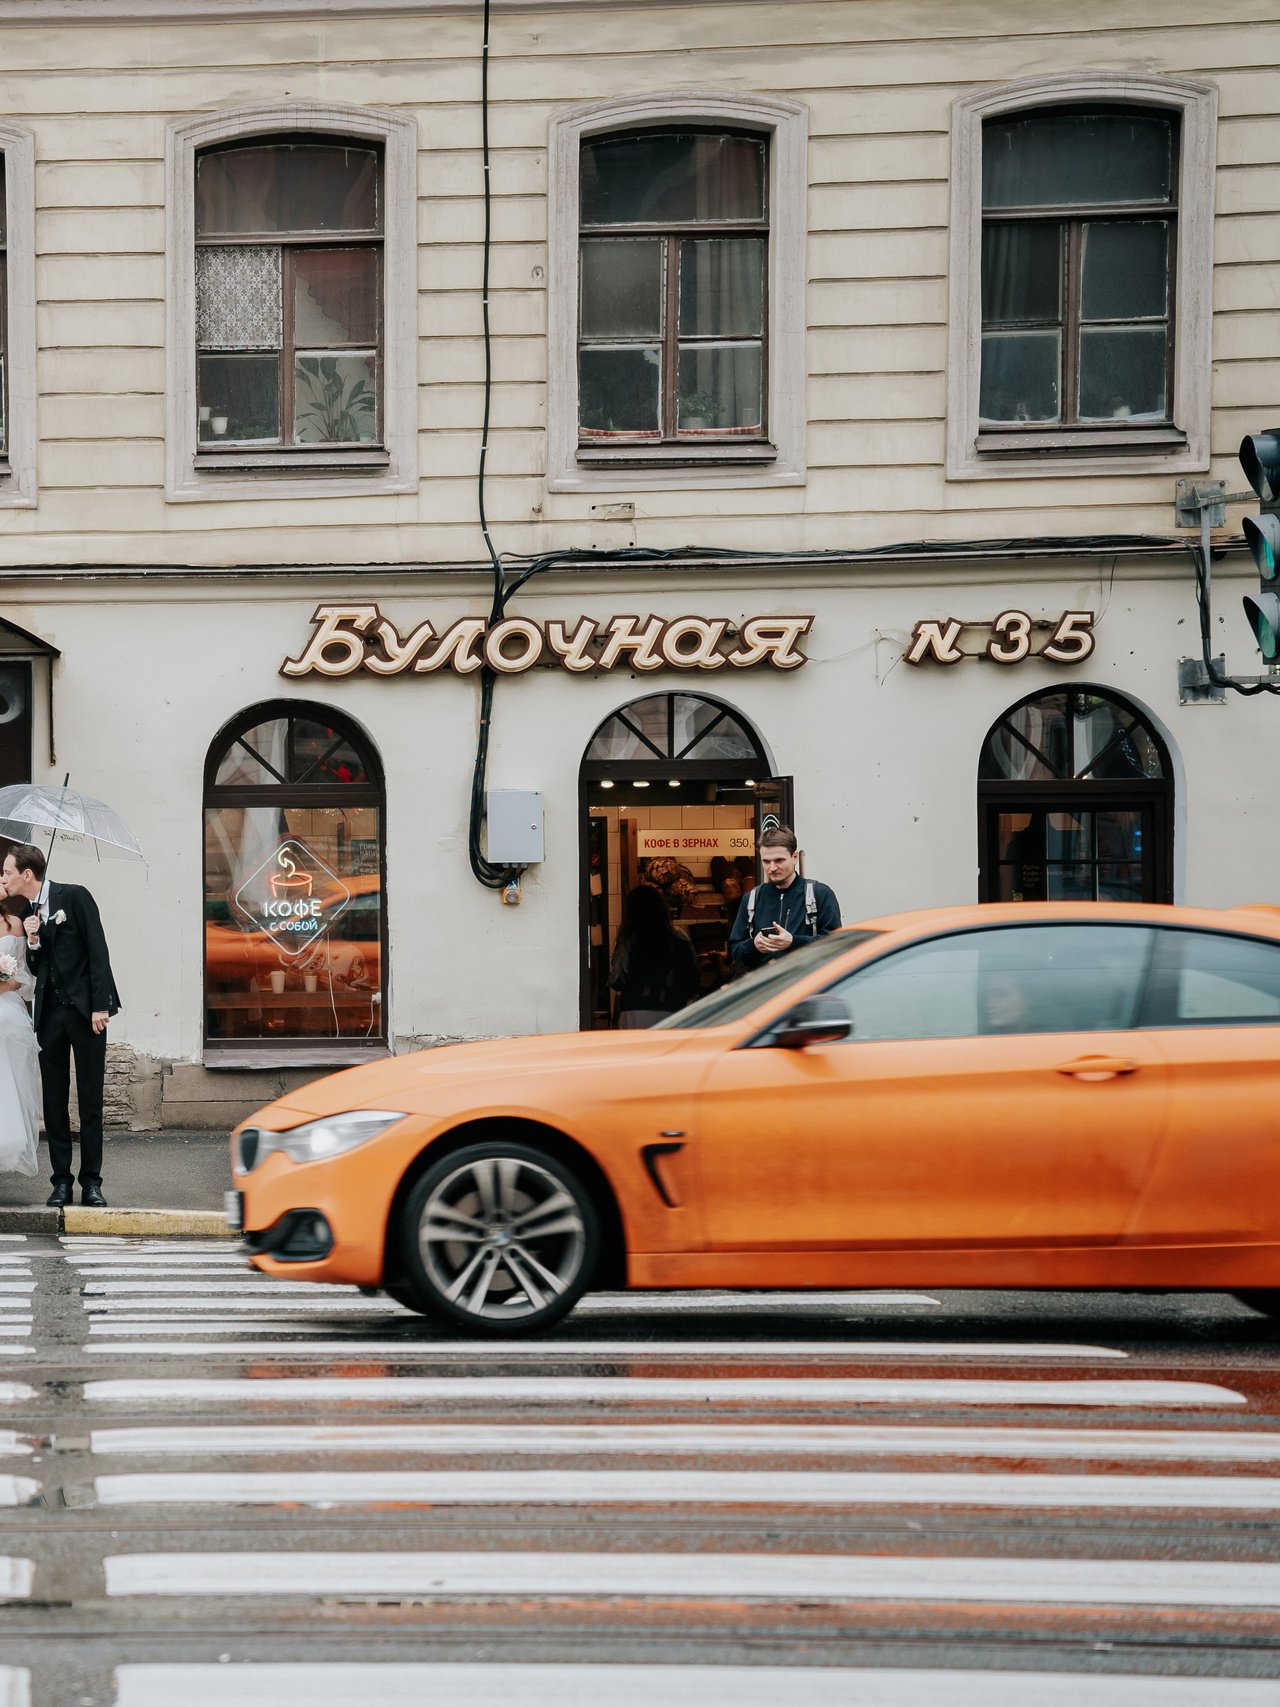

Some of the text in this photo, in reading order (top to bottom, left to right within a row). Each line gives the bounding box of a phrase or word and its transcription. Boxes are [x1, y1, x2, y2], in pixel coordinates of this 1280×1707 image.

[280, 604, 817, 677] Булочная
[644, 838, 671, 848] КОФЕ
[673, 838, 680, 848] В
[682, 838, 719, 848] ЗЕРНАХ
[264, 899, 322, 918] КОФЕ
[270, 918, 318, 931] С СОБОЙ
